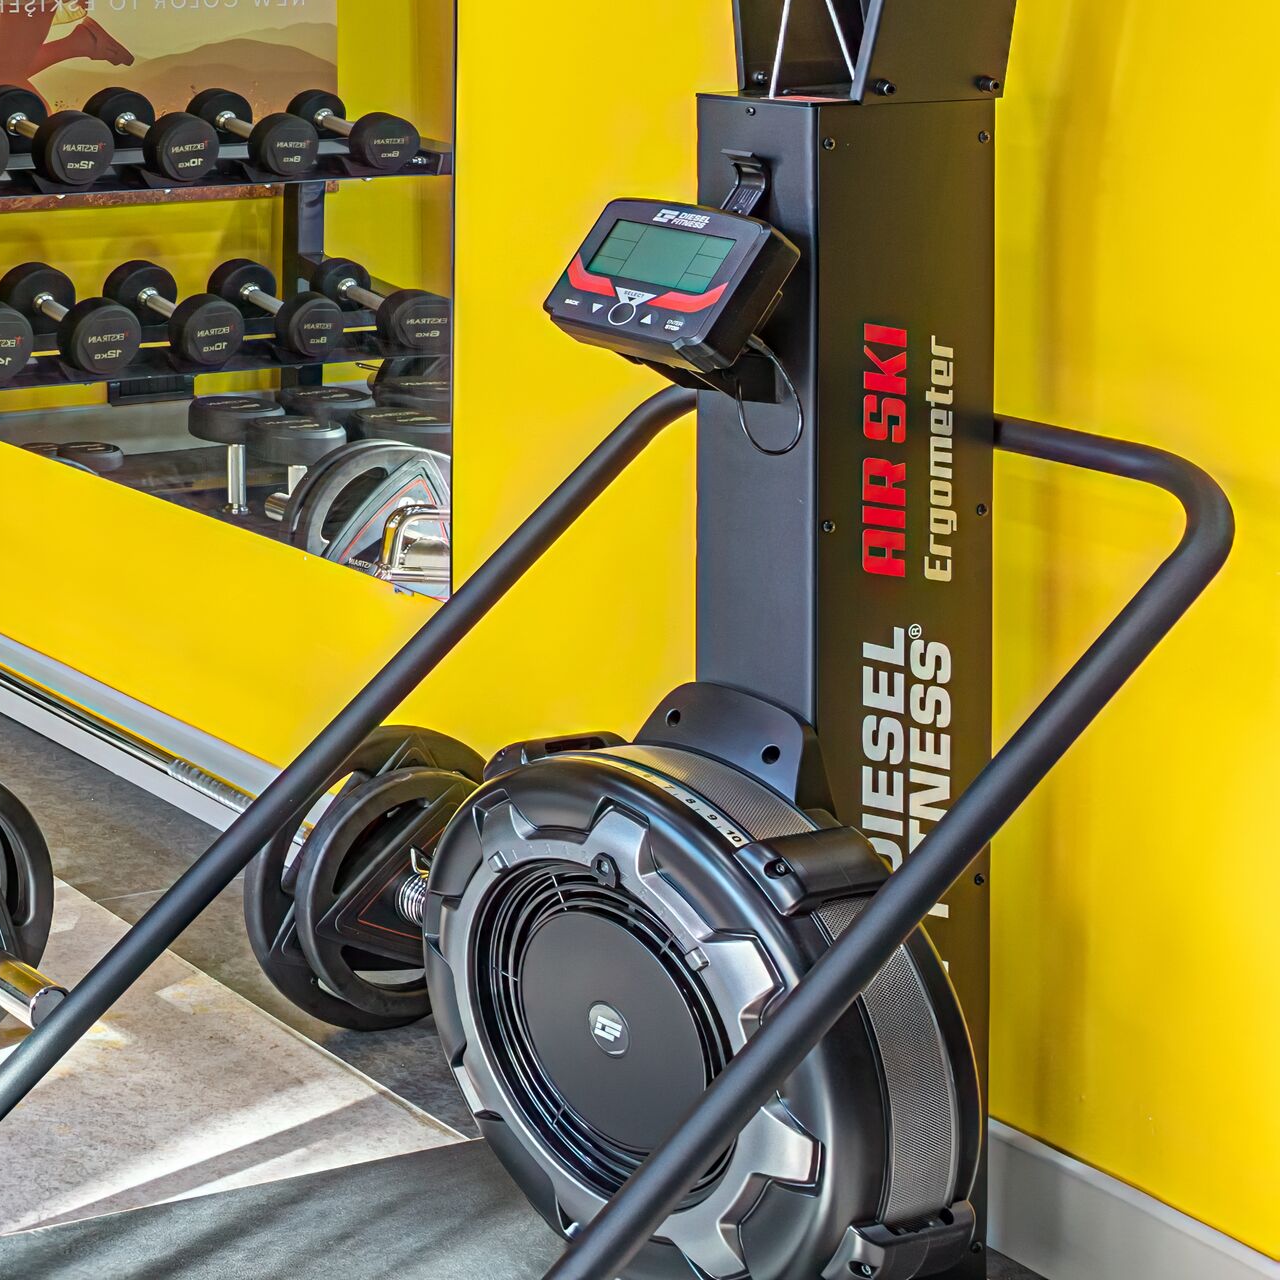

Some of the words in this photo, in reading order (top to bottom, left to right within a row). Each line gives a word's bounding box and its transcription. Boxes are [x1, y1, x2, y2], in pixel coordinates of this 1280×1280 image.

[671, 217, 707, 229] FITNESS
[678, 212, 711, 224] DIESEL
[863, 323, 907, 443] SKI
[924, 334, 958, 583] Ergometer
[862, 456, 907, 578] AIR
[726, 830, 742, 843] 10
